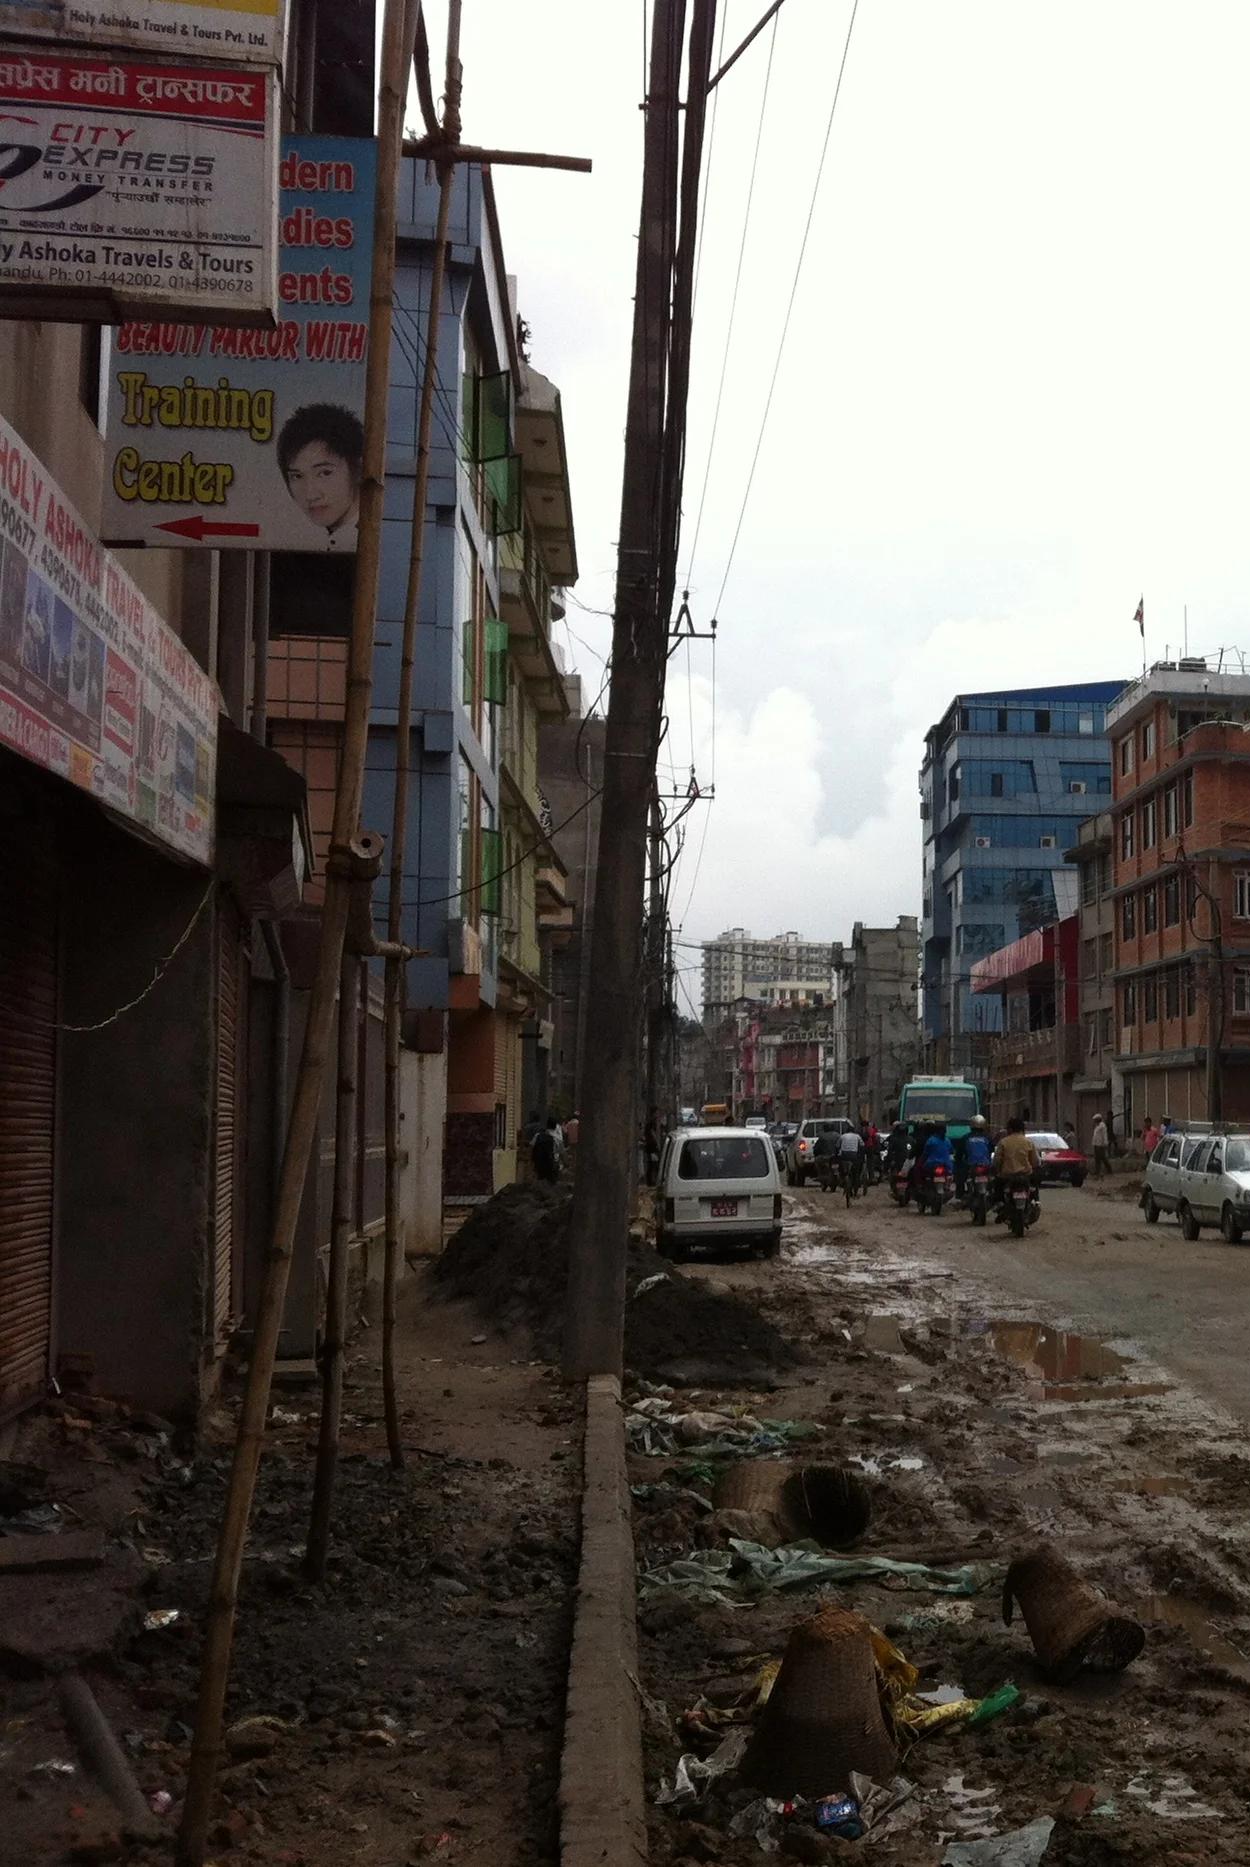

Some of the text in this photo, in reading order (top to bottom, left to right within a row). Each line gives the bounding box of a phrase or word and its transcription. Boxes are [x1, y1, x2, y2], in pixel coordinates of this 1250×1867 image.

[69, 10, 268, 47] Holy Ashoka Travel & Tours Pvt. Ltd.
[69, 66, 128, 96] मनी
[136, 75, 256, 107] ट्रान्सफर
[50, 124, 136, 146] CITY
[43, 146, 216, 176] EXPRESS
[43, 170, 213, 192] MONEY TRANSFER
[279, 150, 355, 192] dern
[279, 206, 355, 248] dies
[18, 241, 96, 264] Ashoka
[102, 246, 173, 270] Travels
[178, 251, 194, 270] &
[200, 252, 254, 274] Tours
[279, 264, 354, 305] ents
[116, 320, 369, 363] BEAUTY PARLOR WITH
[117, 371, 275, 443] Training
[0, 429, 43, 524] HOLY
[113, 446, 234, 504] Center
